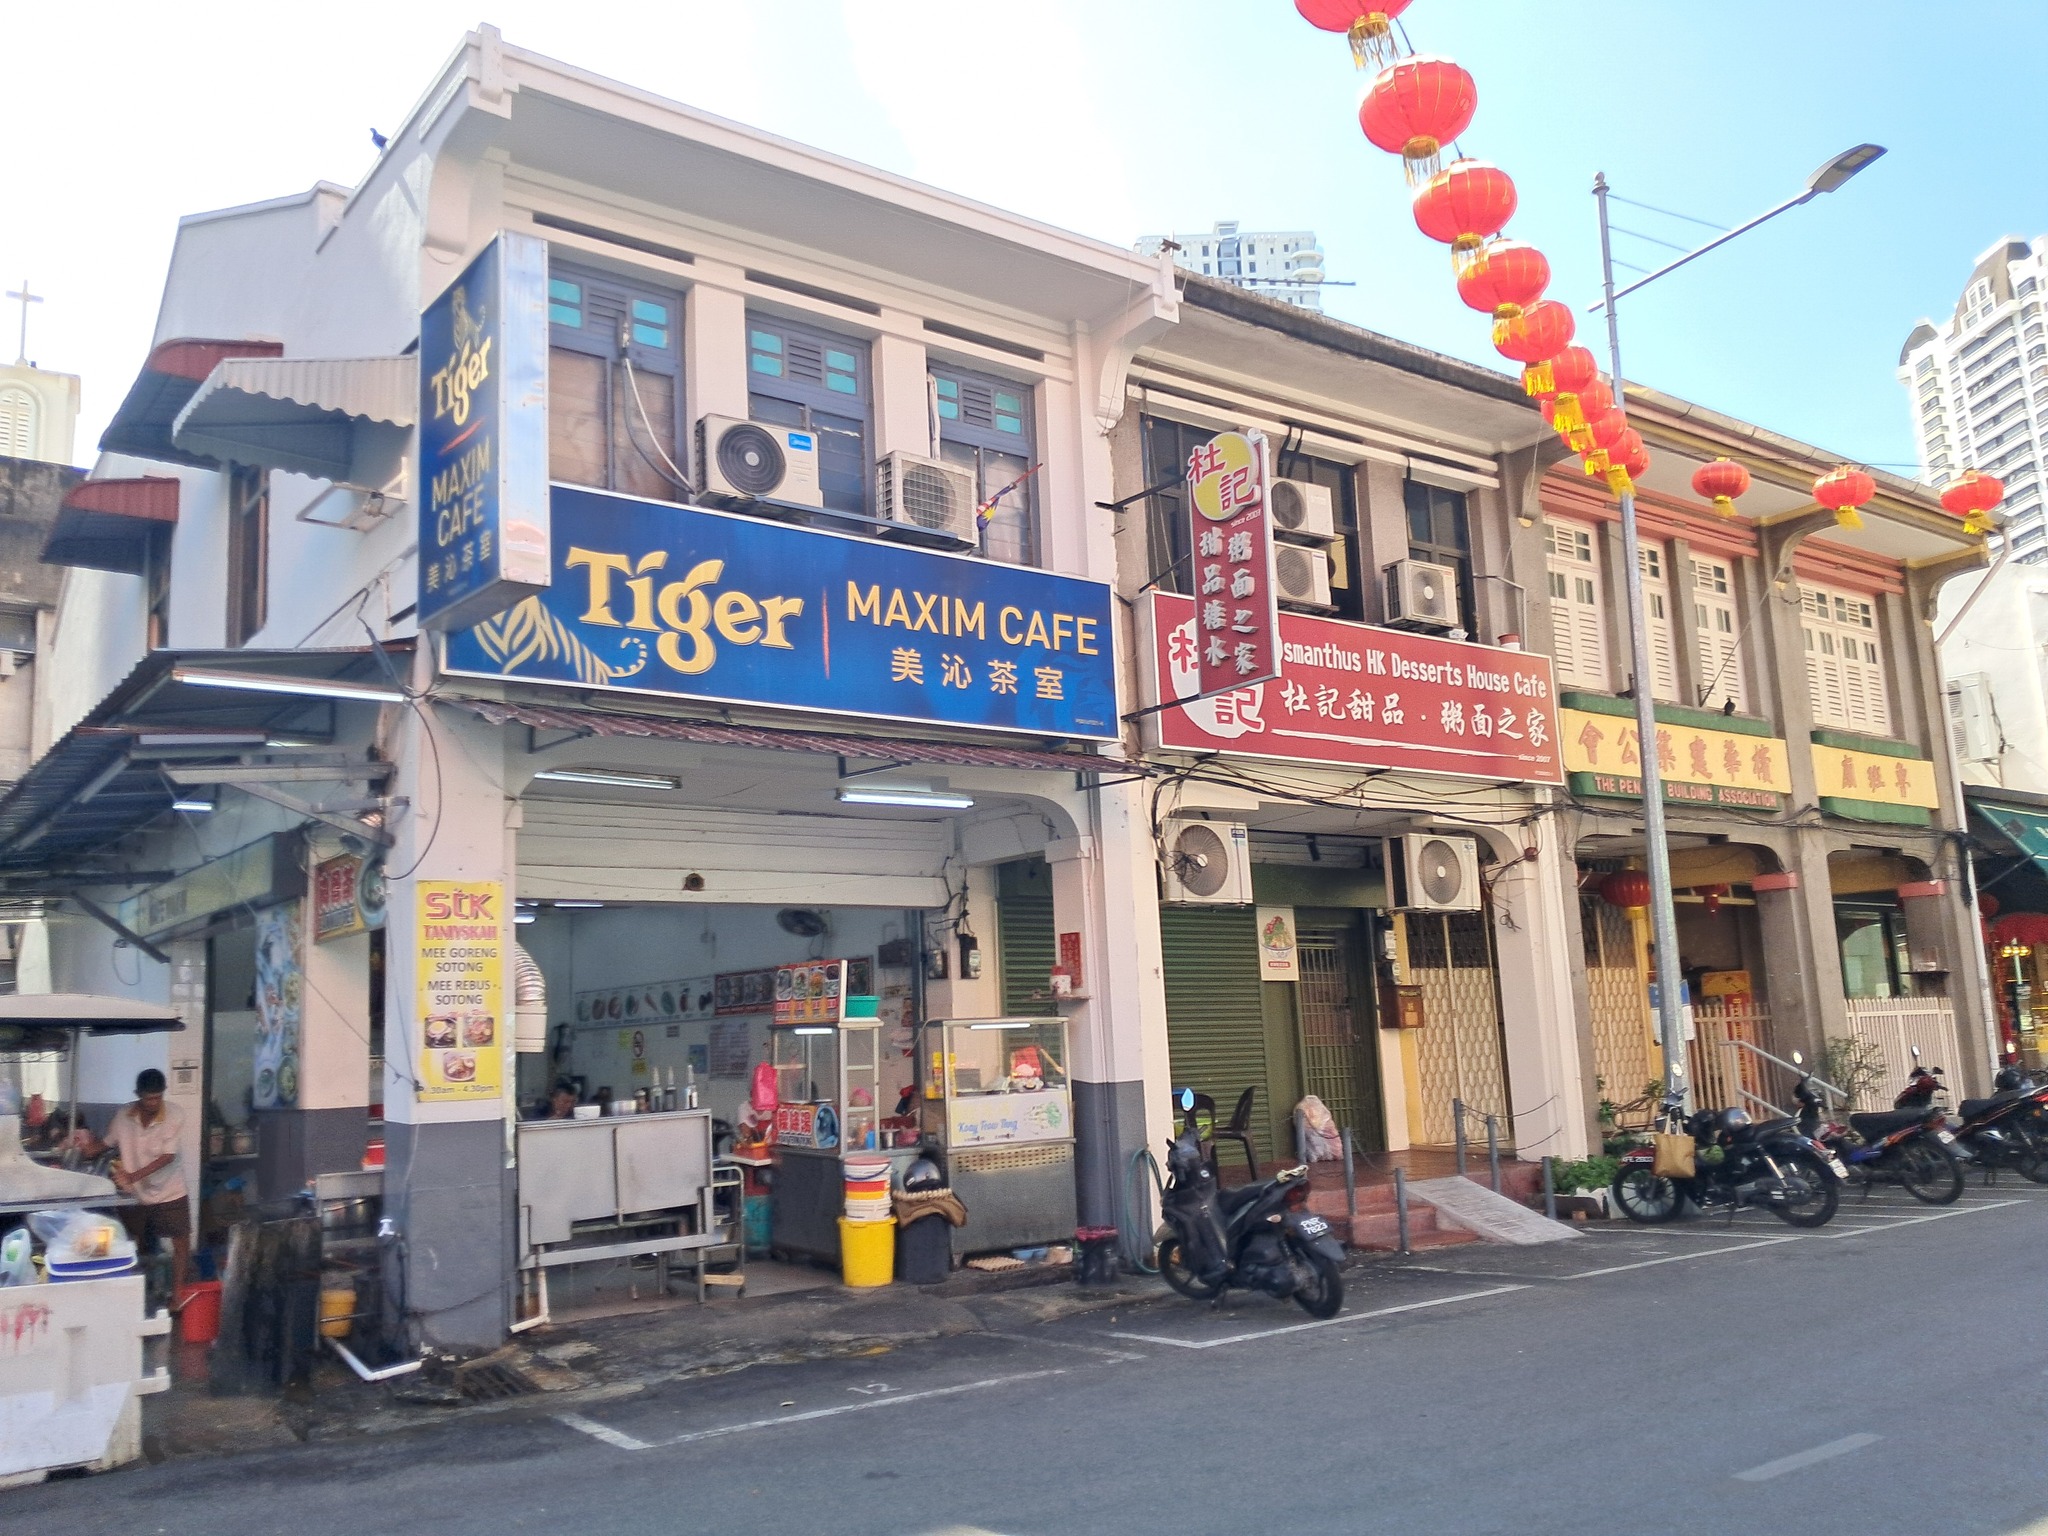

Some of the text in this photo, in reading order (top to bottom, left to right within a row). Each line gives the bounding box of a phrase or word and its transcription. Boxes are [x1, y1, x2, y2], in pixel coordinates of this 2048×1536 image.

[431, 335, 491, 426] Tiger
[432, 436, 491, 512] MAXIM
[438, 482, 484, 547] CAFE
[565, 546, 804, 675] Tiger
[847, 580, 1099, 656] MAXIM CAFE
[891, 646, 1065, 701] 美沁茶室
[1280, 642, 1547, 698] smanthus HK Desserts House Cafe
[1594, 775, 1615, 793] THE
[1667, 782, 1713, 801] BUILDING
[1718, 788, 1777, 808] ASSOCIATION
[421, 947, 497, 959] MEE GORENG
[435, 961, 484, 973] SOTONG
[427, 979, 491, 992] MEE REBUS
[435, 994, 483, 1006] SOTONG
